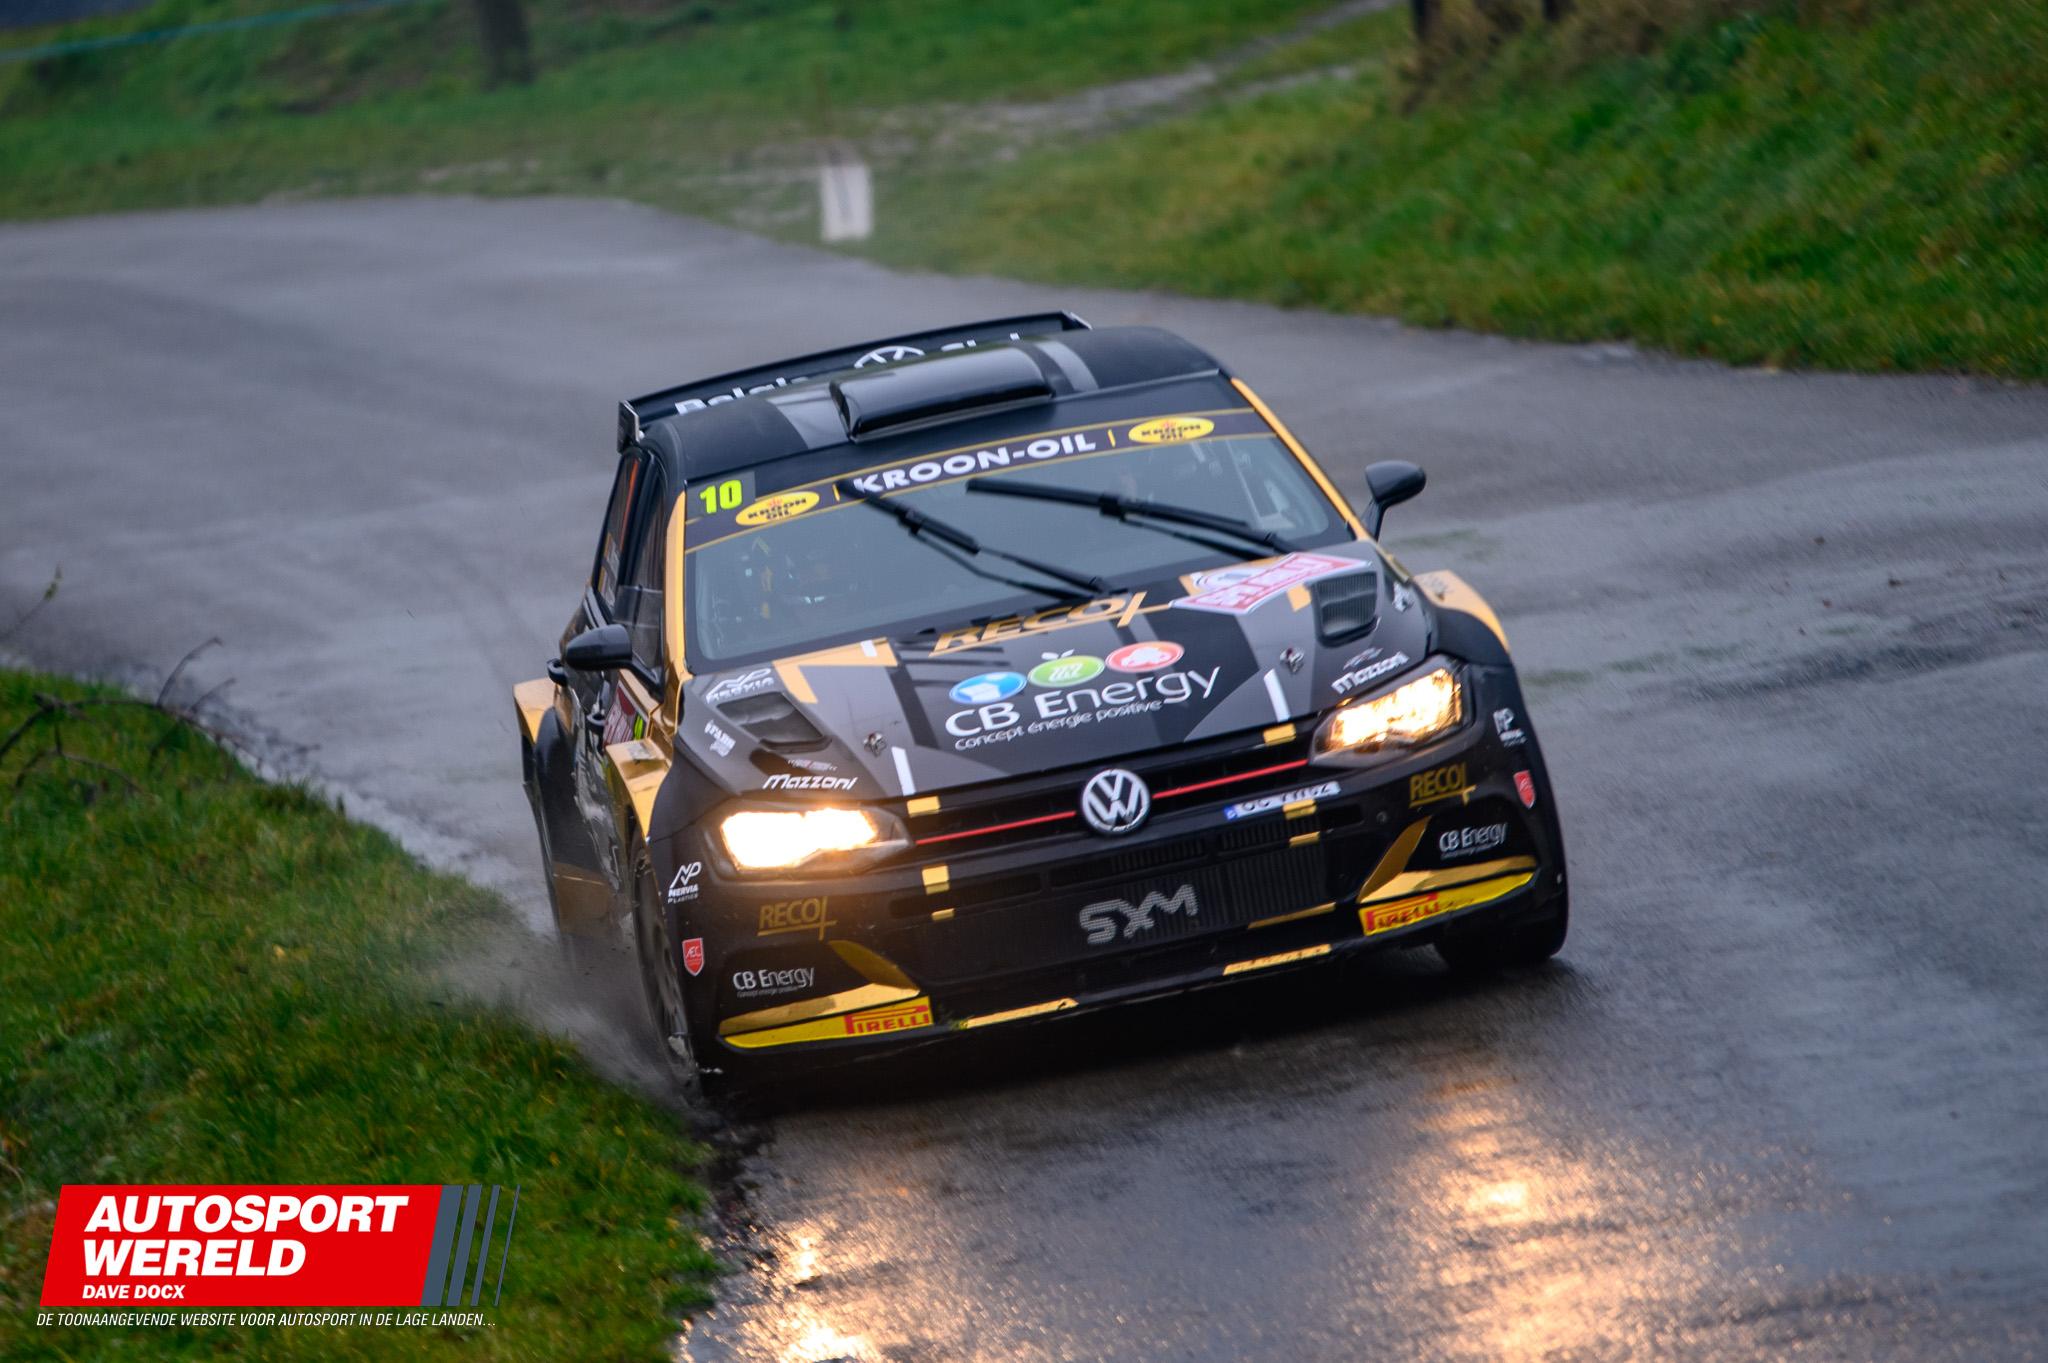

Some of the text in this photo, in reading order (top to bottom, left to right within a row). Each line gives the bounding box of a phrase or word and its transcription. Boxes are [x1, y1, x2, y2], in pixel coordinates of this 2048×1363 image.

[853, 434, 1096, 492] KROON-OIL
[700, 480, 742, 514] 10
[945, 666, 1221, 737] CB Energy
[955, 699, 1164, 751] concept énergie positive
[1461, 822, 1508, 849] Energy
[733, 967, 815, 990] CB Energy
[844, 1005, 930, 1034] PIRELLI
